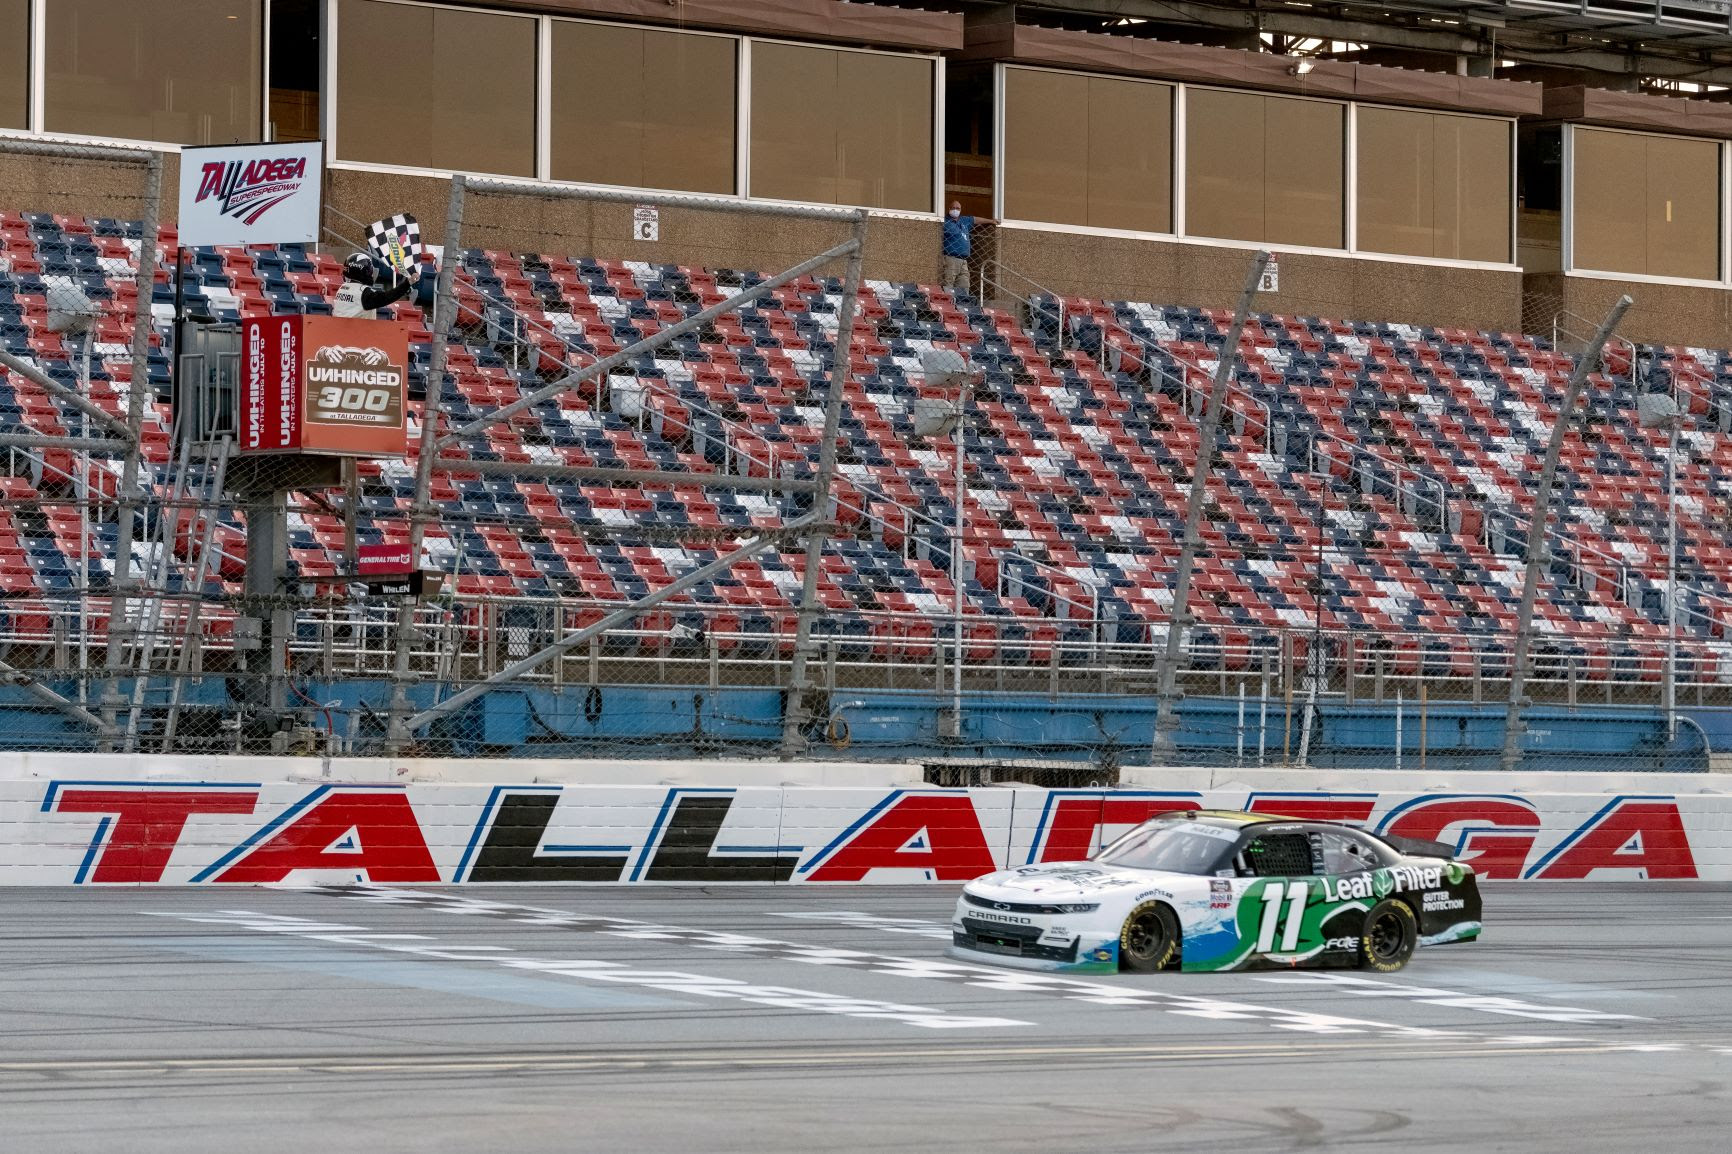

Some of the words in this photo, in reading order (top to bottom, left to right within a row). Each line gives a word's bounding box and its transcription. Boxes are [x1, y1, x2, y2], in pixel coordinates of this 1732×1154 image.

[195, 157, 306, 215] TALLADEGA
[230, 182, 301, 205] SUPERSPEEDWAY
[641, 222, 652, 239] C
[1263, 274, 1273, 290] B
[260, 338, 265, 350] 10
[291, 335, 296, 347] 10
[280, 321, 291, 446] UNHINGED
[308, 367, 400, 387] UNHINGED
[249, 323, 260, 448] UNHINGED
[317, 386, 391, 412] 300
[337, 413, 376, 421] TALLADEGA
[260, 424, 265, 434] IN
[291, 422, 296, 432] IN
[359, 556, 386, 564] GENERAL
[382, 584, 411, 594] WHELEN
[1422, 891, 1450, 901] GUTTER
[1422, 900, 1465, 912] PROTECTION
[968, 910, 1032, 925] CAMARO
[1255, 881, 1310, 954] 11
